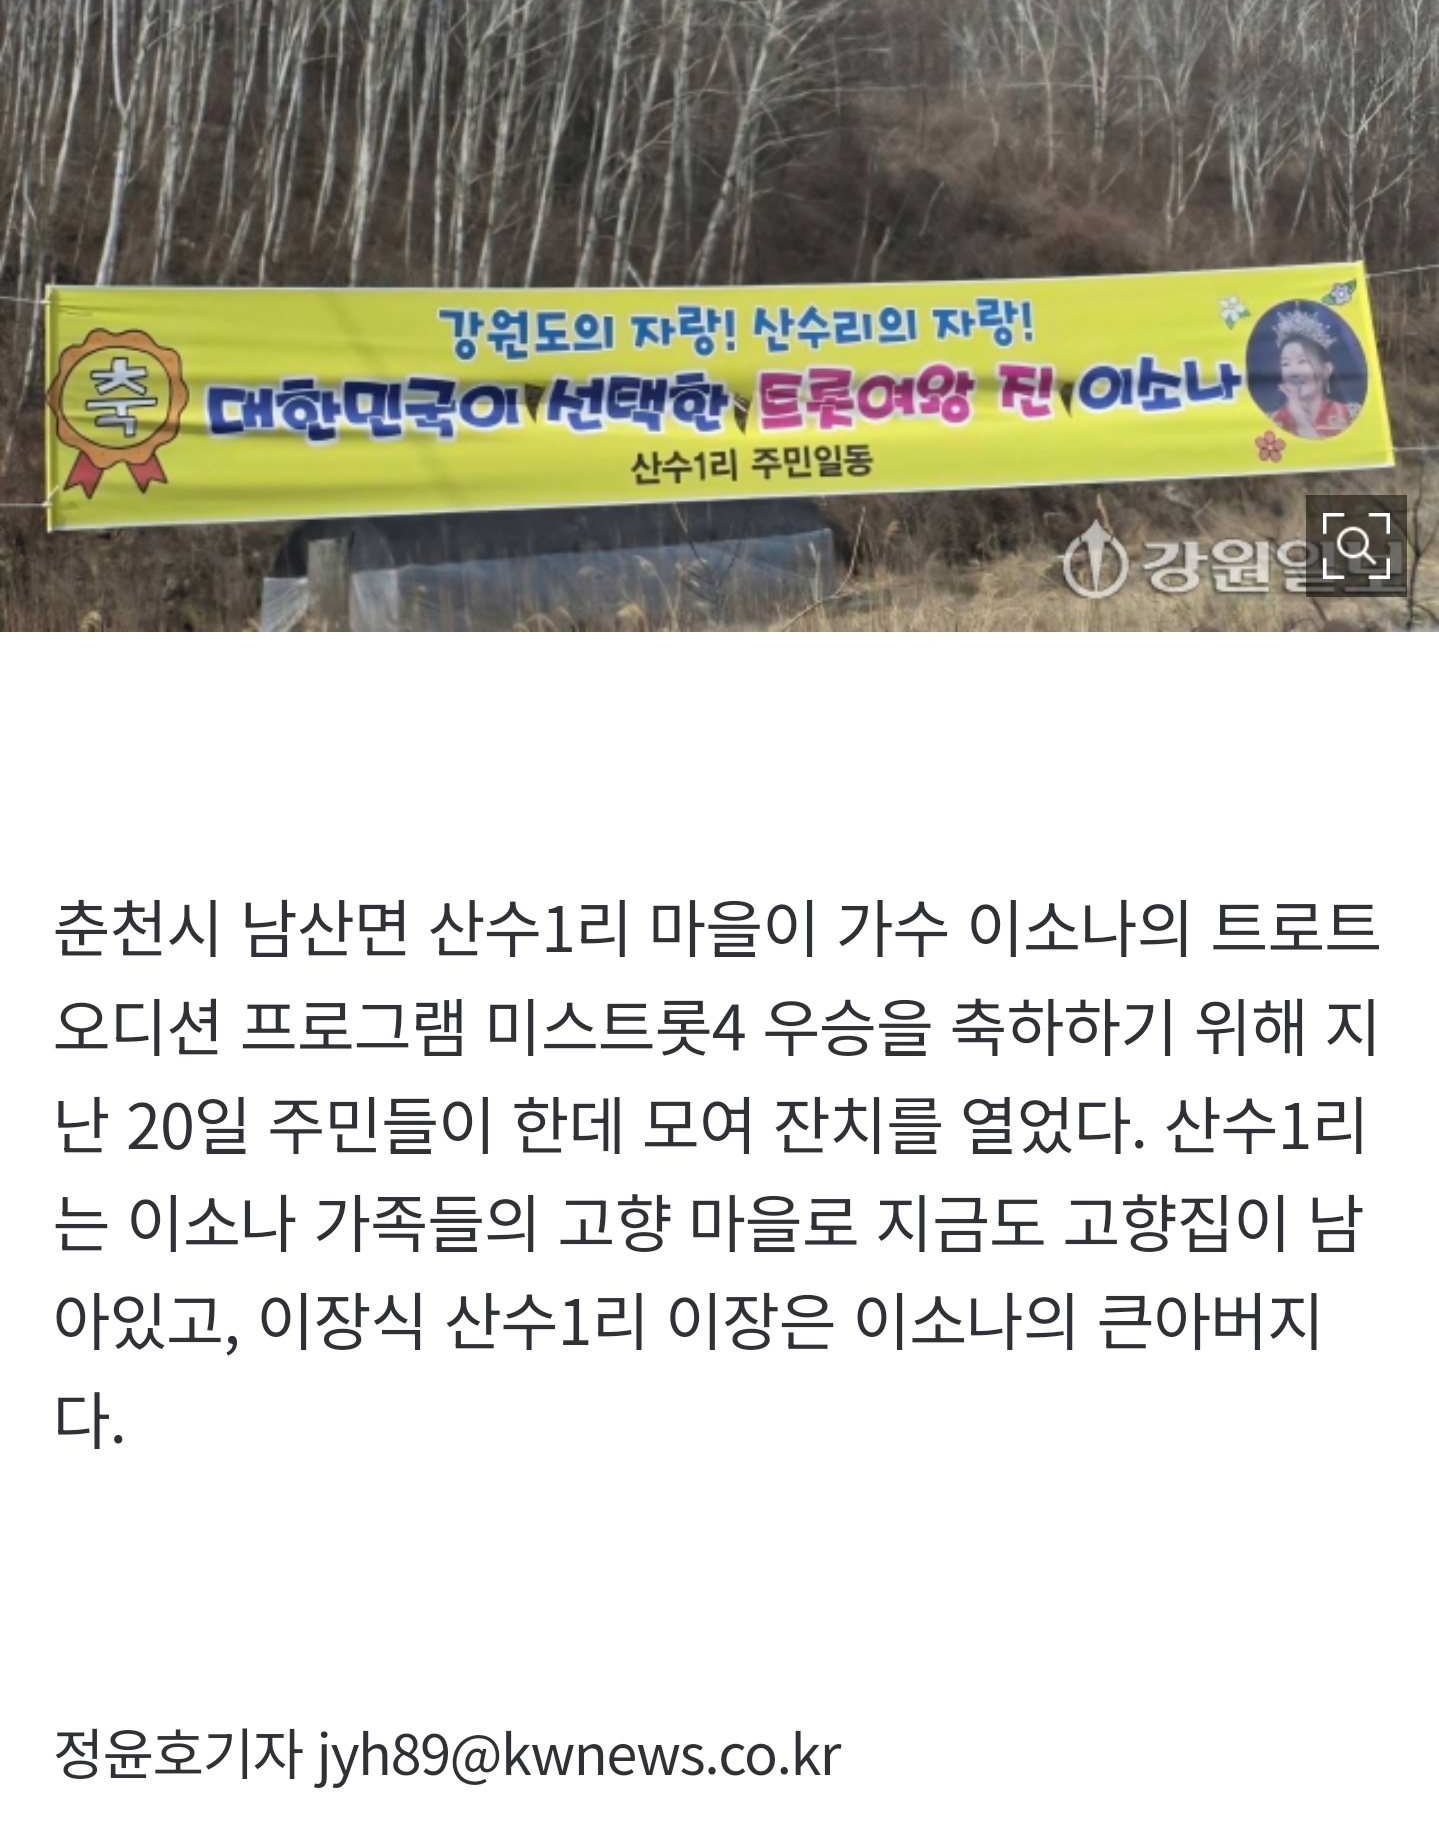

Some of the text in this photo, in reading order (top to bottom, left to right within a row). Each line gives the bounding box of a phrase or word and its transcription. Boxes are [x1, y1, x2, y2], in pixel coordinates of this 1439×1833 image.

[437, 297, 1034, 361] 강원도의 자랑! 산수리의 자랑!
[85, 356, 158, 438] 축
[206, 354, 1244, 445] 대한민국이 선택한 트롯여왕 진 이소나
[630, 443, 874, 486] 산수1리 주민일동
[55, 900, 1379, 957] 춘천시 남산면 산수1리 마을이 가수 이소나의 트로트
[55, 998, 1374, 1056] 오디션 프로그램 미스트롯4 우승을 축하하기 위해 지
[58, 1097, 1362, 1154] 난 20일 주민들이 한데 모여 잔치를 열었다. 산수1리
[55, 1194, 1363, 1252] 는 이소나 가족들의 고향 마을로 지금도 고향집이 남
[56, 1293, 1317, 1356] 아있고, 이장식 산수1리 이장은 이소나의 큰아버지
[58, 1392, 123, 1449] 다.
[56, 1728, 842, 1788] 정윤호기자 jyh89@kwnews.co.kr
